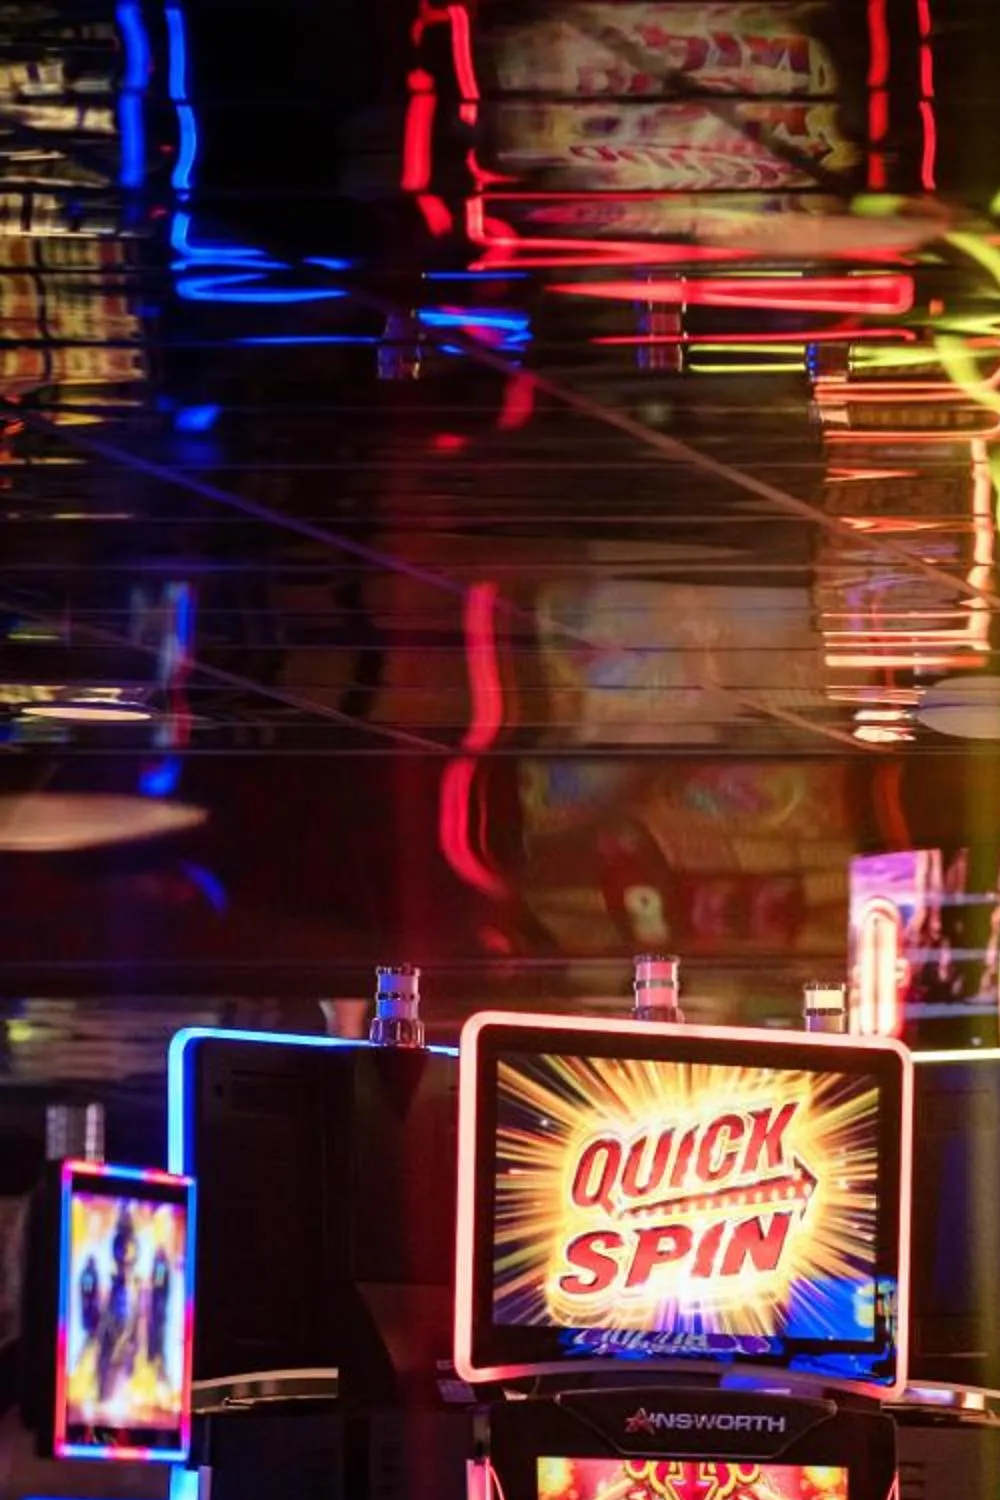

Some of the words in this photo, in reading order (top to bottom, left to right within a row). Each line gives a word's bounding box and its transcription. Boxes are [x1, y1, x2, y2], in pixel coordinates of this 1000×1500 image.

[570, 1102, 800, 1218] QUICK
[559, 1211, 793, 1295] SPIN
[625, 1408, 786, 1434] AINSWORTH
